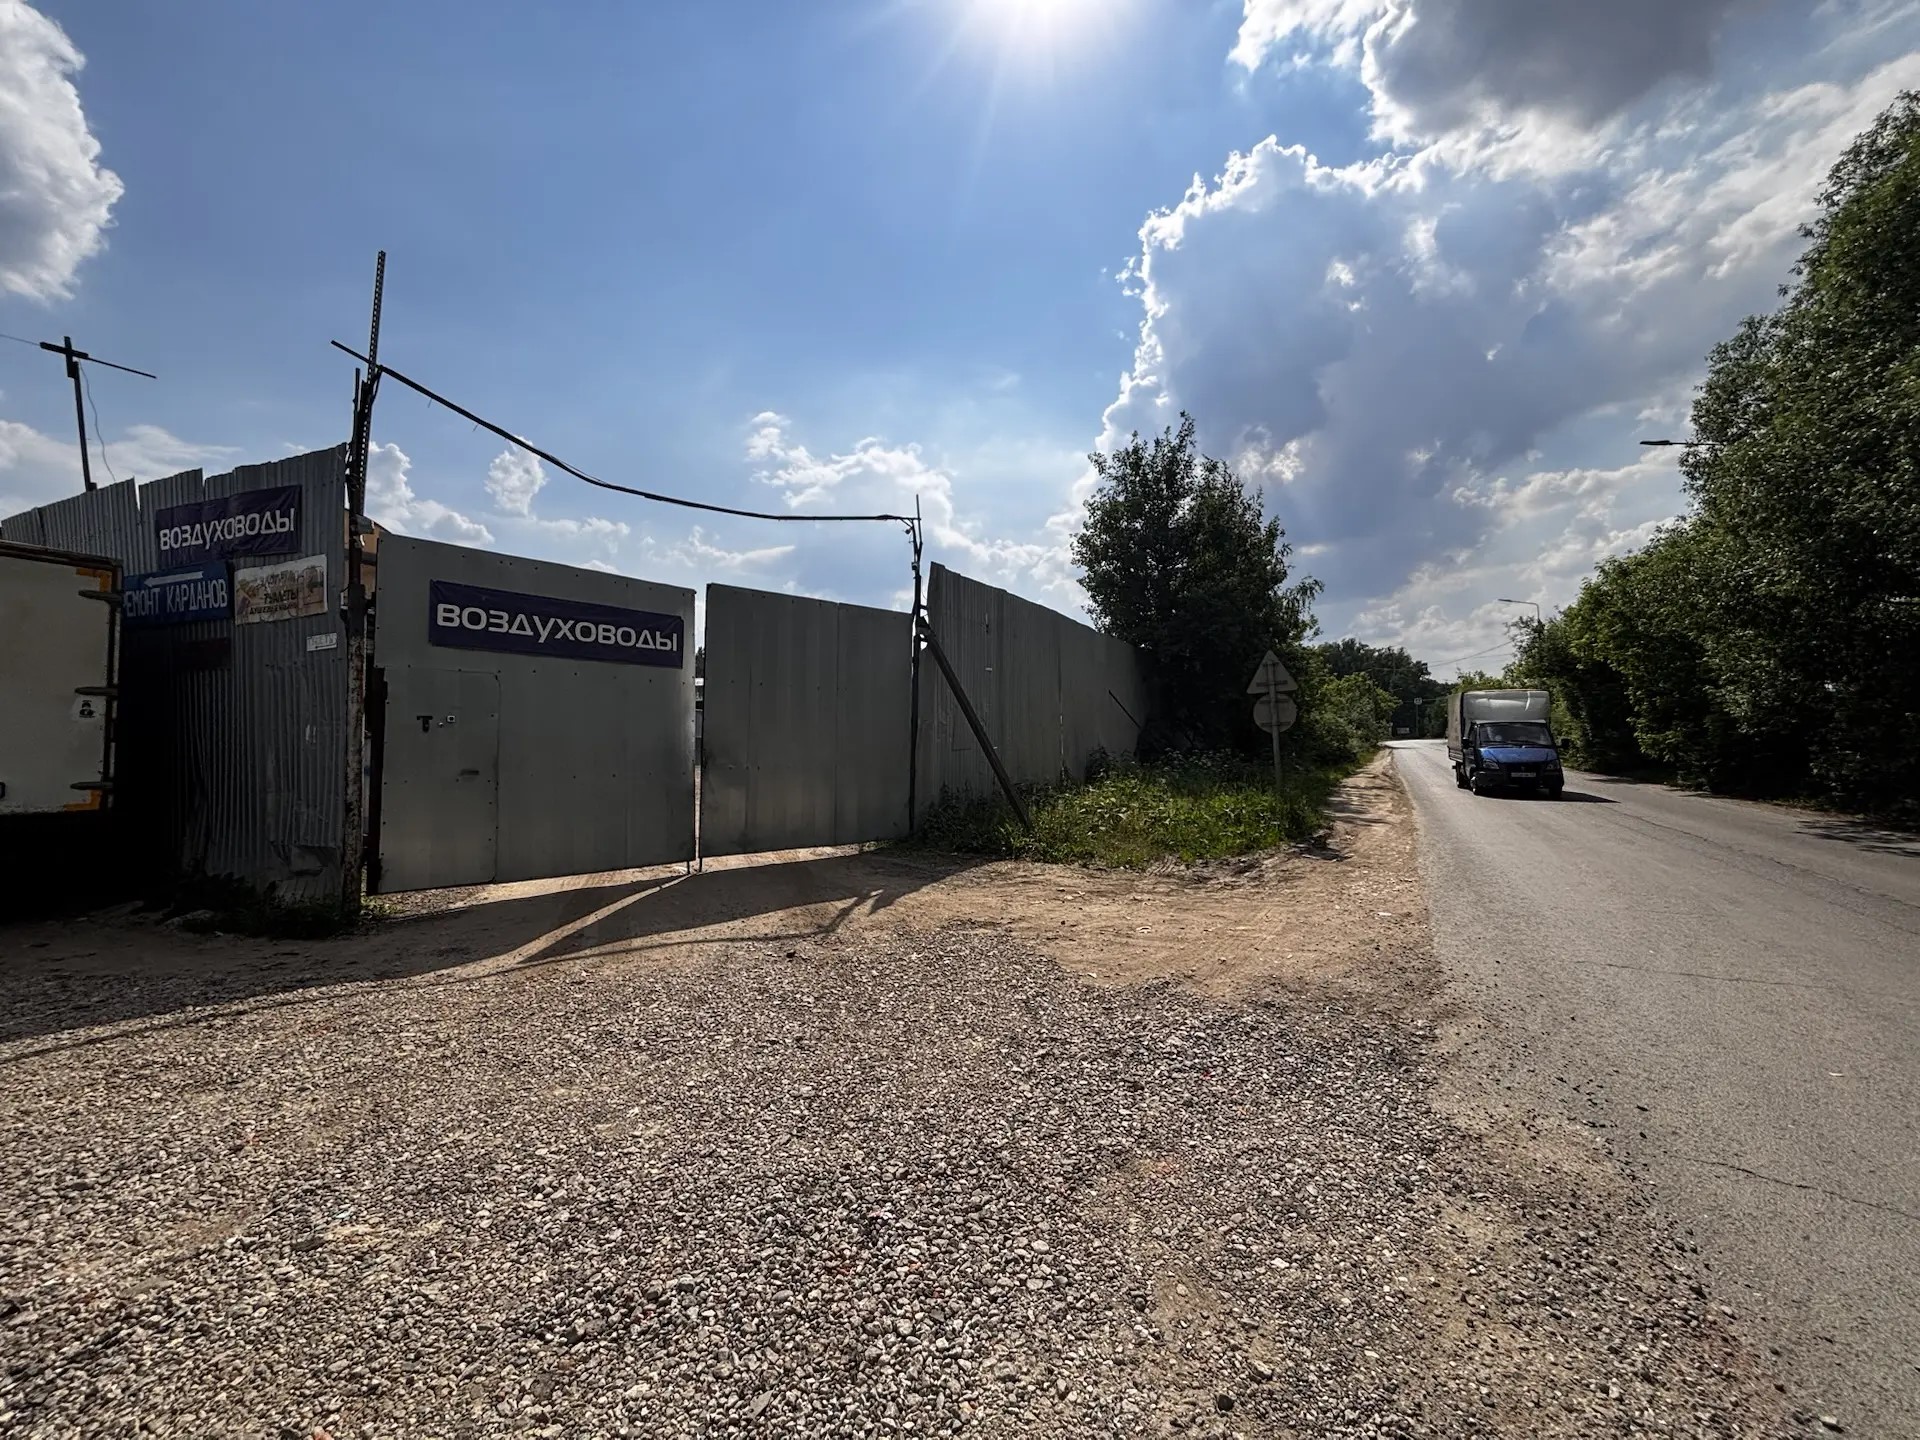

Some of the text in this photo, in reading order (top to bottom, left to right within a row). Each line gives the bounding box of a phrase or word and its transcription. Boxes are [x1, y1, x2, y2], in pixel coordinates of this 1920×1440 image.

[160, 508, 295, 550] ВОЗДУХОВОДЫ
[166, 579, 228, 613] КАРДАНОВ
[437, 603, 678, 652] ВОЗДУХОВОДЫ
